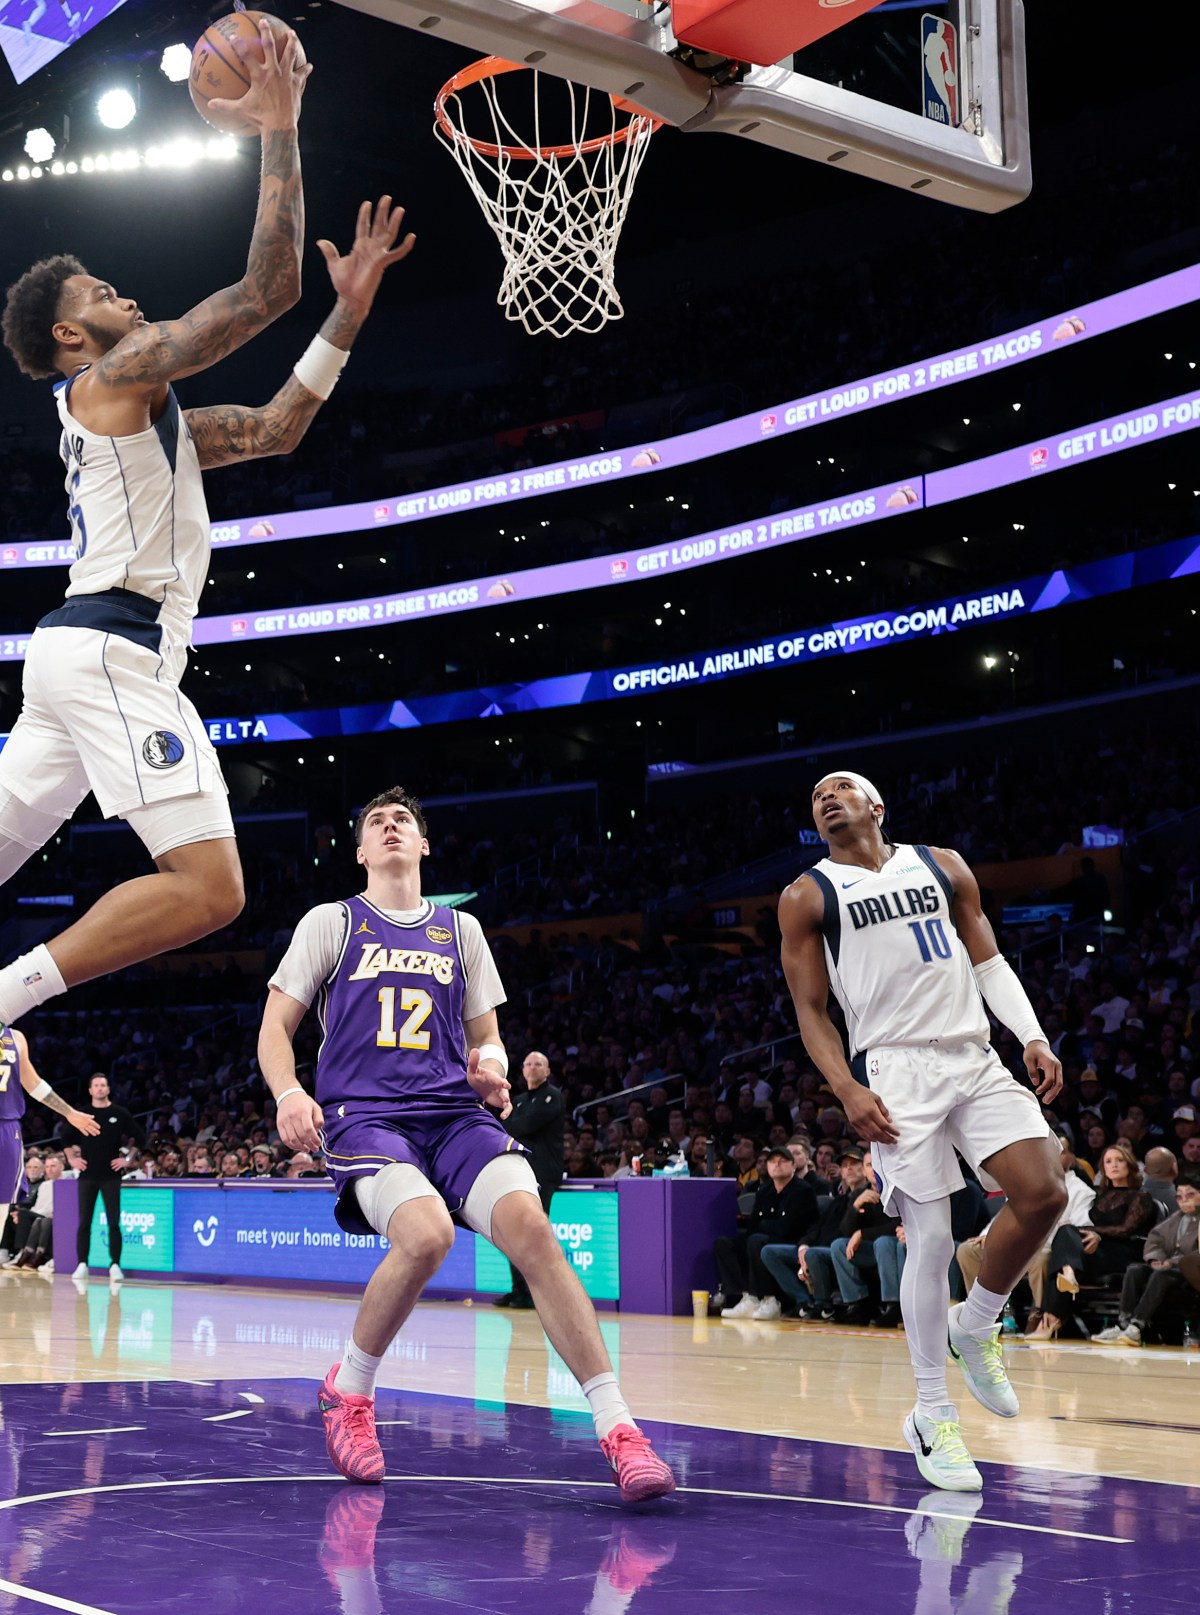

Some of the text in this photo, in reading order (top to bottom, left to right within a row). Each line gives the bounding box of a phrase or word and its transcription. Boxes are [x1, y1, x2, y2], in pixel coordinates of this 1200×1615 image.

[928, 100, 945, 122] NBA
[784, 401, 818, 426] GET
[820, 386, 869, 413] LOUD
[873, 374, 910, 400] FOR
[914, 368, 926, 388] 2
[930, 353, 978, 382] FREE
[981, 330, 1042, 366] TACOS
[1057, 431, 1097, 459] GET
[1100, 413, 1158, 447] LOUD
[397, 498, 427, 517] GET
[428, 489, 472, 512] LOUD
[474, 480, 507, 501] FOR
[510, 477, 520, 494] 2
[523, 467, 565, 491] FREE
[567, 456, 622, 481] TACOS
[25, 546, 56, 562] GET
[210, 525, 240, 543] COS
[636, 550, 669, 572] GET
[671, 540, 716, 566] LOUD
[719, 528, 754, 553] FOR
[756, 525, 767, 545] 2
[770, 513, 815, 540] FREE
[818, 496, 876, 525] TACOS
[254, 612, 286, 633] GET
[288, 609, 334, 630] LOUD
[336, 606, 370, 624] FOR
[373, 604, 383, 620] 2
[386, 598, 425, 618] FREE
[427, 586, 479, 609] TACOS
[4, 639, 16, 655] 2
[613, 588, 1025, 692] OFFICIAL AIRLINE OF CRYPTO.COM ARENA
[209, 720, 268, 740] ELTA
[896, 865, 925, 876] chime
[847, 885, 940, 931] DALLAS
[428, 929, 451, 939] bibigo
[908, 919, 952, 962] 10
[348, 943, 455, 985] LAKERS
[376, 986, 433, 1050] 12
[237, 1228, 267, 1244] meet
[270, 1231, 300, 1249] your
[304, 1227, 341, 1247] home
[345, 1231, 375, 1248] loan
